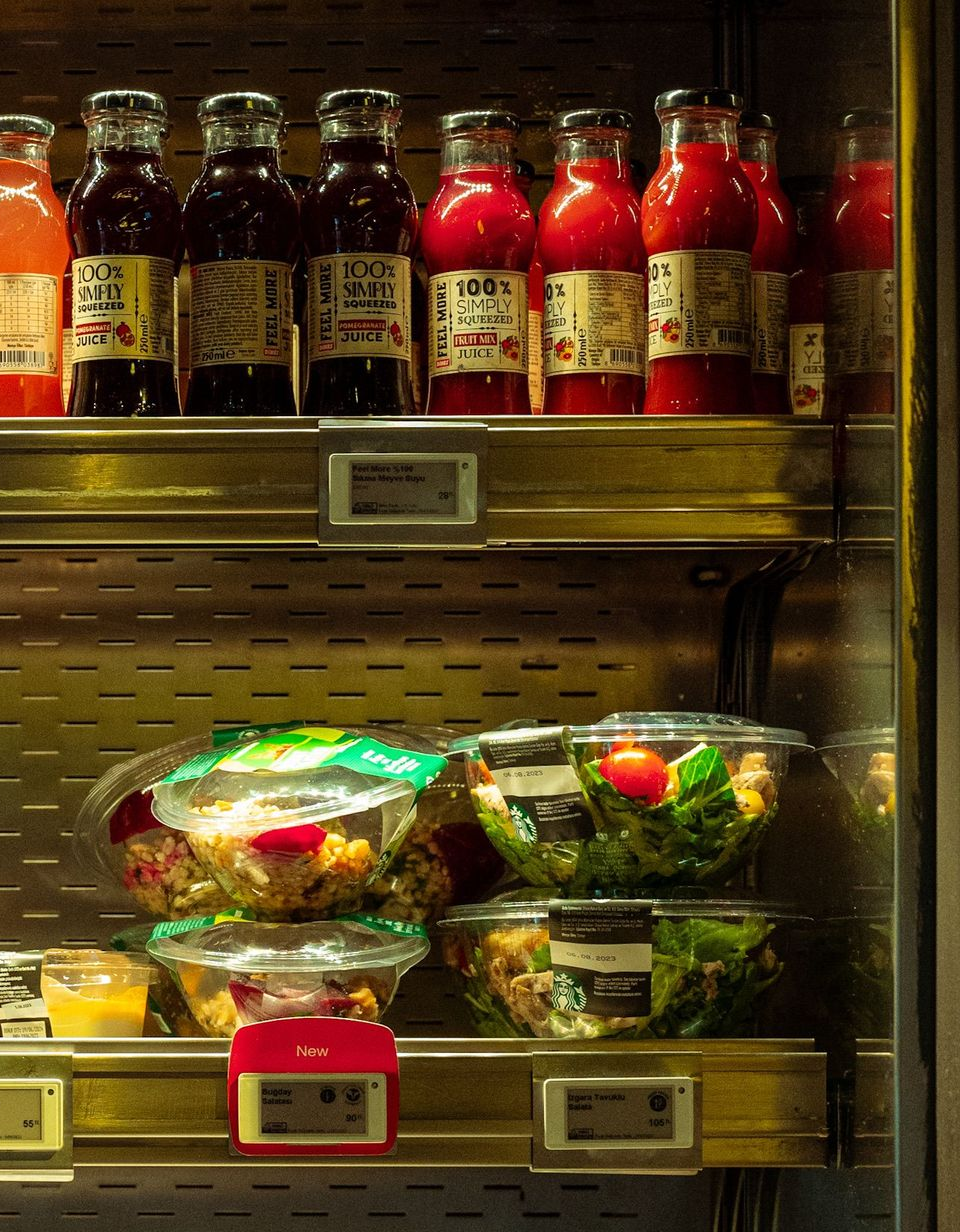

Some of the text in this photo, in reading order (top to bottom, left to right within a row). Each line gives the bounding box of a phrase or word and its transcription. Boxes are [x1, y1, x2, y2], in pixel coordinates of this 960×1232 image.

[78, 263, 124, 283] 100%
[343, 261, 395, 278] 100%
[78, 283, 124, 303] SIMPLY
[343, 281, 396, 298] SIMPLY
[456, 279, 511, 297] 100%
[78, 302, 124, 312] SQUEEZED
[266, 270, 277, 346] FEEL MORE
[320, 263, 332, 341] FEEL MORE
[343, 299, 396, 309] SQUEEZED
[457, 299, 512, 314] SIMPLY
[436, 282, 447, 357] FEEL MORE
[457, 315, 513, 325] SQUEEZED
[339, 322, 386, 330] POMEGRANATE
[77, 334, 107, 346] JUICE
[341, 332, 383, 342] JUICE
[455, 333, 496, 346] FRUIT MIX
[458, 349, 494, 359] JUICE
[406, 475, 425, 483] Suyu
[296, 1045, 329, 1056] New
[23, 1120, 33, 1128] 55
[346, 1114, 356, 1122] 90
